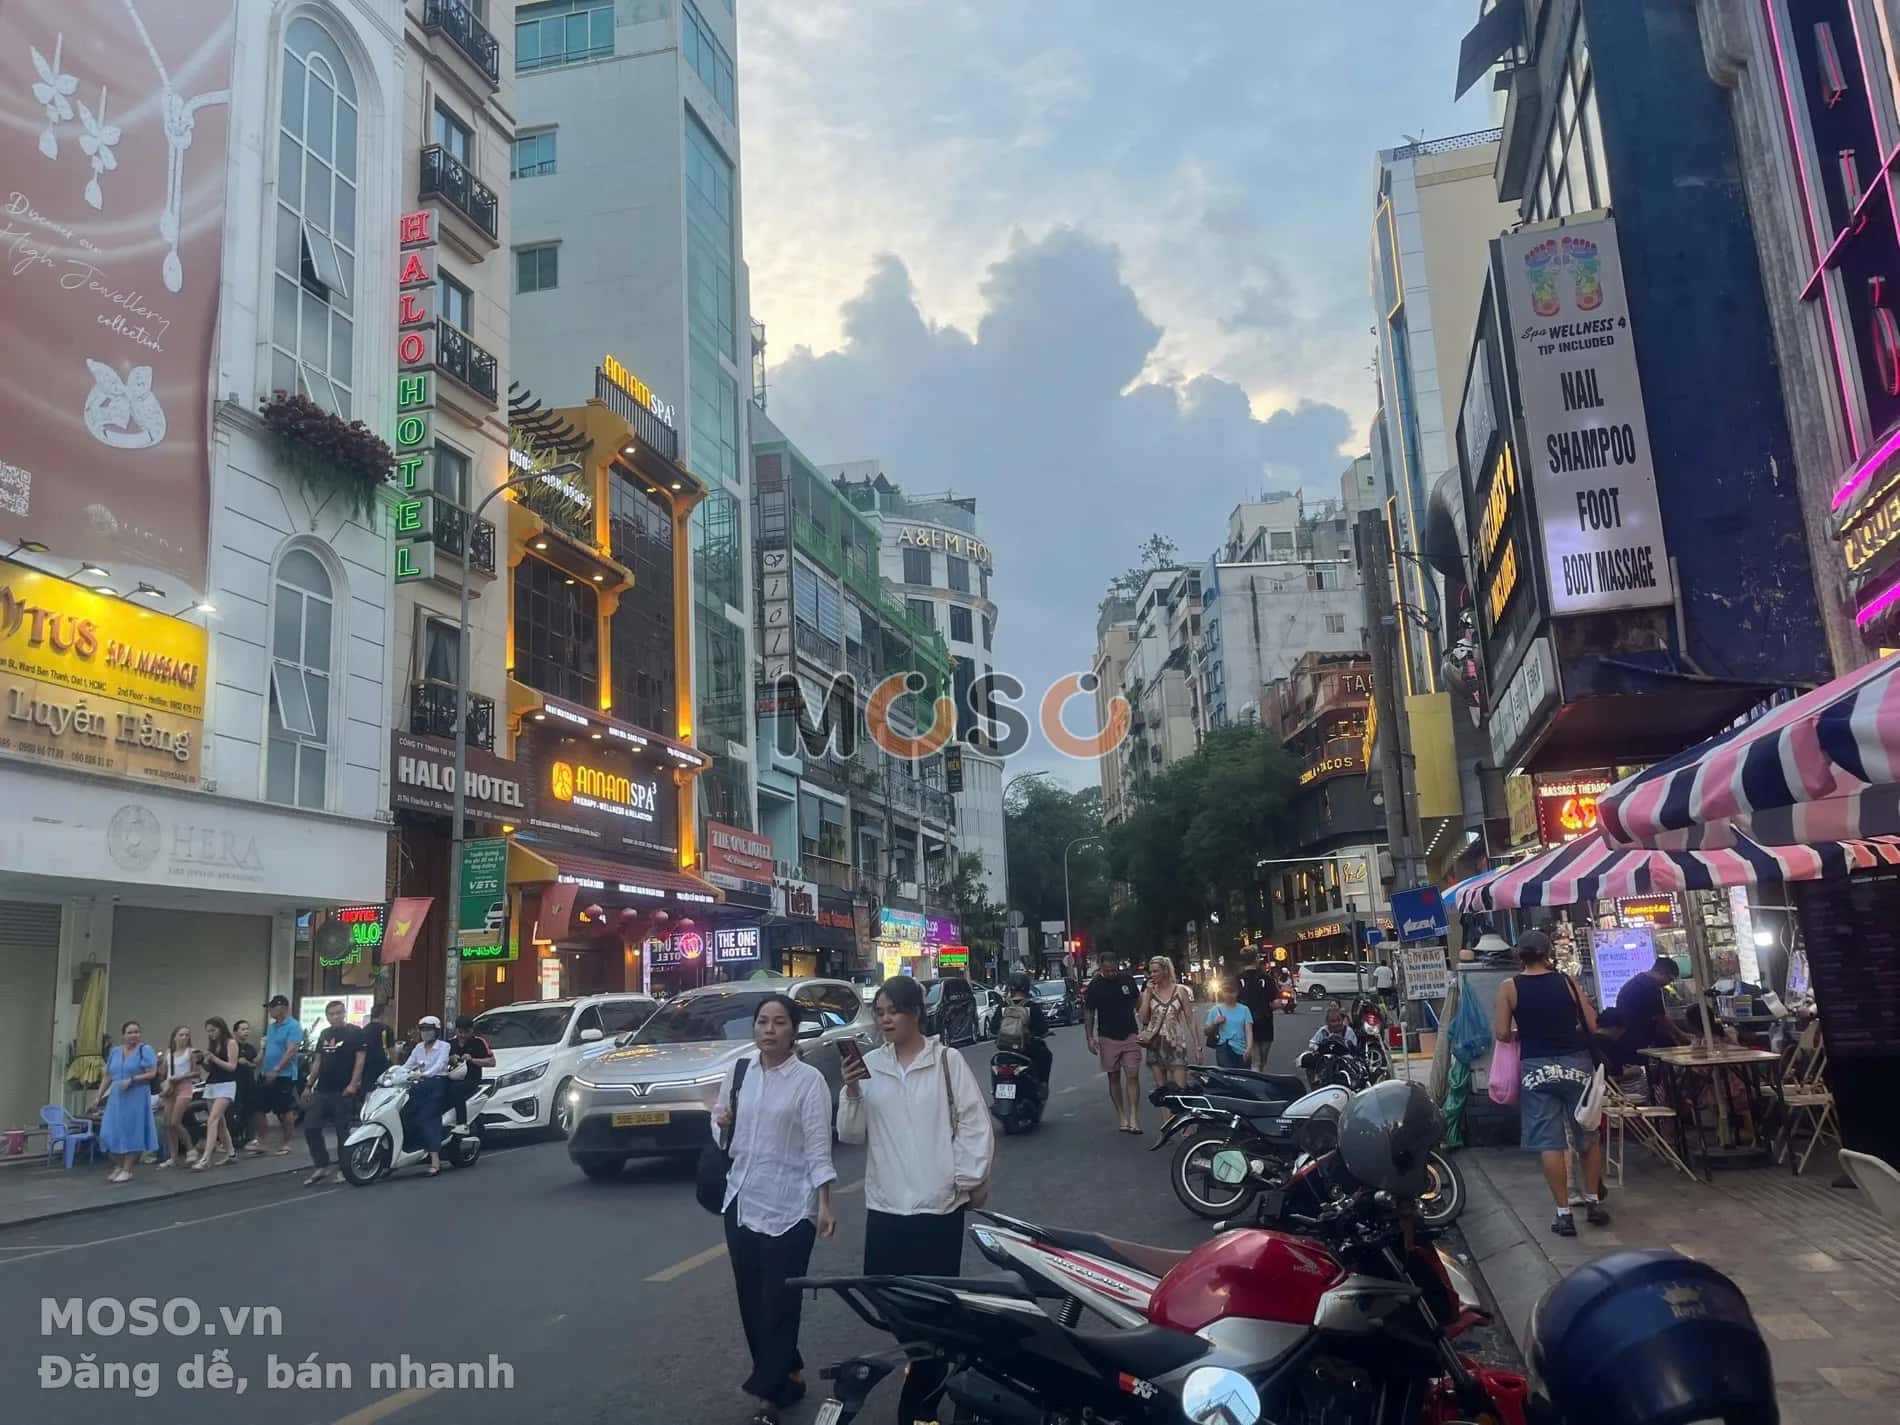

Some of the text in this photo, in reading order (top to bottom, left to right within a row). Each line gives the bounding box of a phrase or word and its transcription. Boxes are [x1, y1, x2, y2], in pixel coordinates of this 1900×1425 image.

[60, 259, 170, 342] Jewellery
[97, 314, 164, 352] collection
[1521, 325, 1548, 341] Spa
[1549, 319, 1614, 339] WELLNESS
[1538, 335, 1614, 356] TIP INCLUDED
[397, 210, 429, 577] HALO HOTEL
[1561, 368, 1604, 411] NAIL
[1547, 423, 1637, 474] SHAMPOO
[1576, 487, 1622, 532] FOOT
[1562, 546, 1657, 596] BODY MASSAGE
[135, 650, 199, 690] MASSAGE
[398, 755, 525, 808] HALO HOTEL
[576, 765, 631, 805] ANNAM
[1540, 785, 1577, 797] MASSAGE
[169, 823, 265, 872] HERA
[469, 880, 498, 890] VETC
[718, 931, 757, 948] THE ONE
[721, 946, 753, 957] HOTEL
